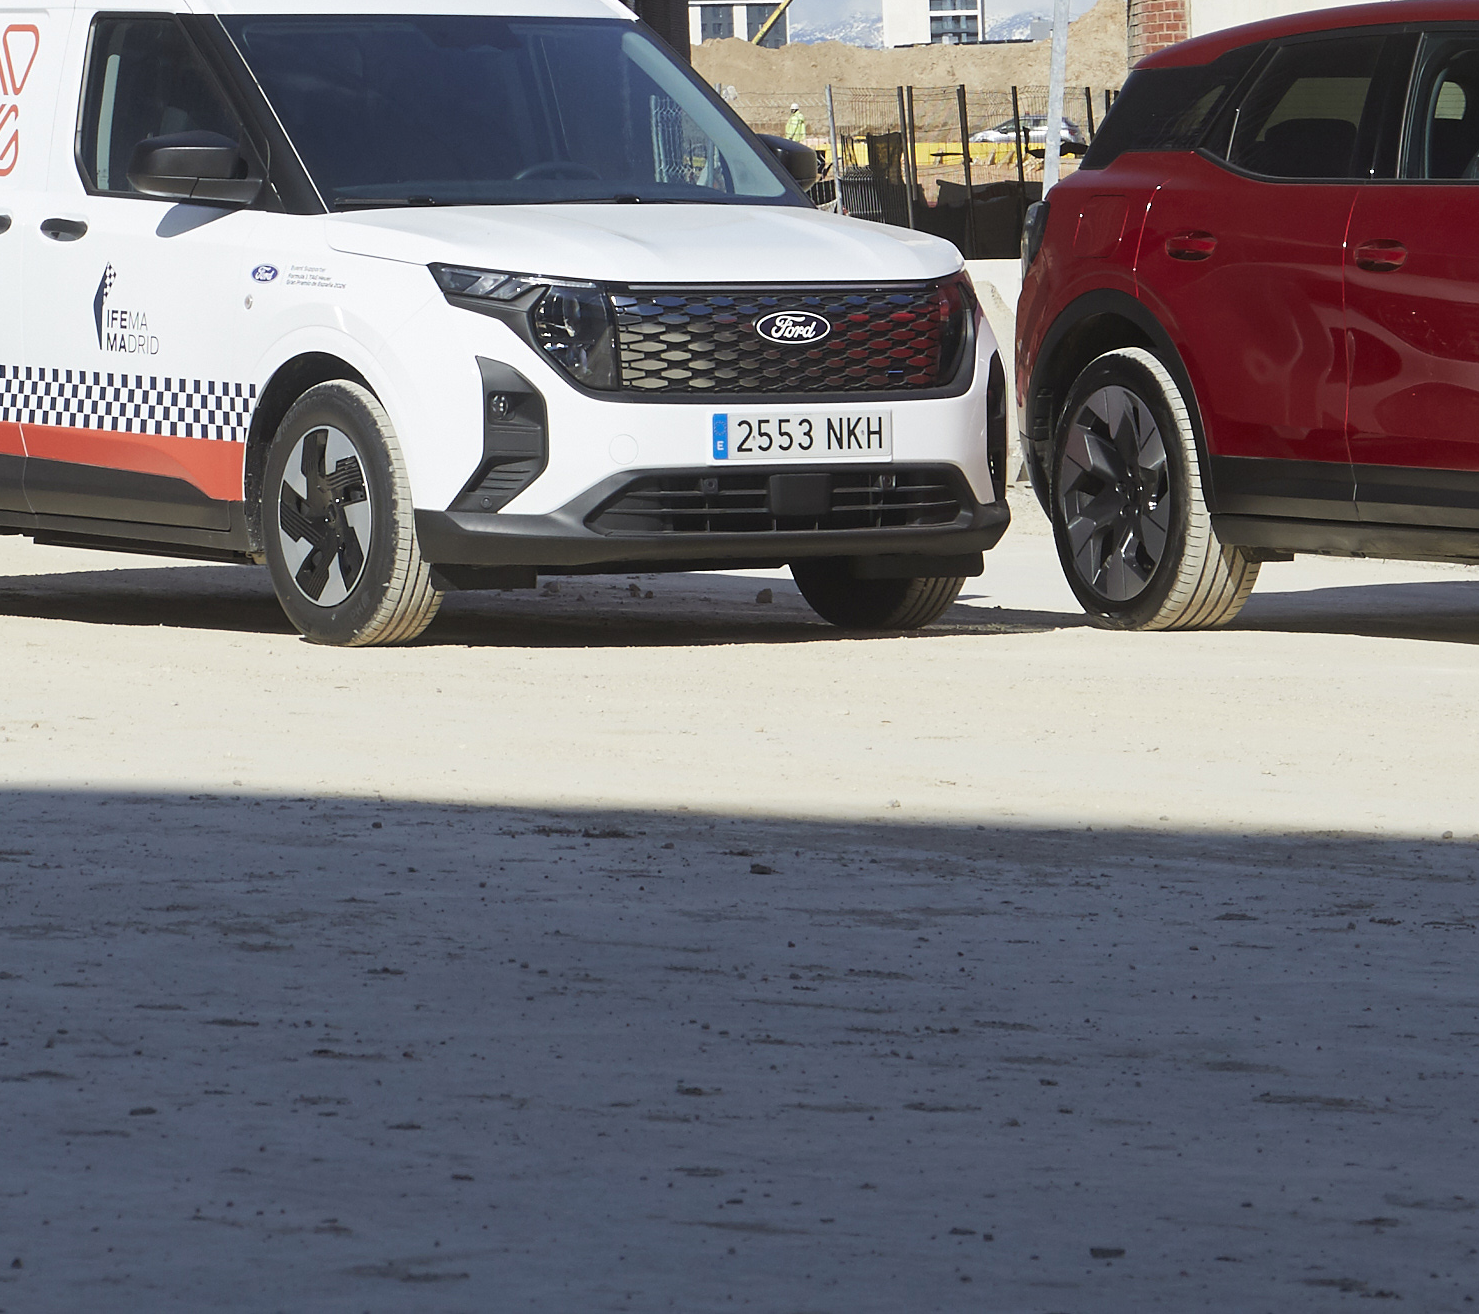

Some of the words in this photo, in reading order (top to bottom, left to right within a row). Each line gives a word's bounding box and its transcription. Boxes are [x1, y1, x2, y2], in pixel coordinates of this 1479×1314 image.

[106, 309, 148, 331] IFEMA
[768, 314, 820, 340] Ford
[106, 332, 160, 355] MADRID
[716, 441, 724, 450] E
[737, 418, 814, 453] 2553
[827, 417, 883, 450] NKH
